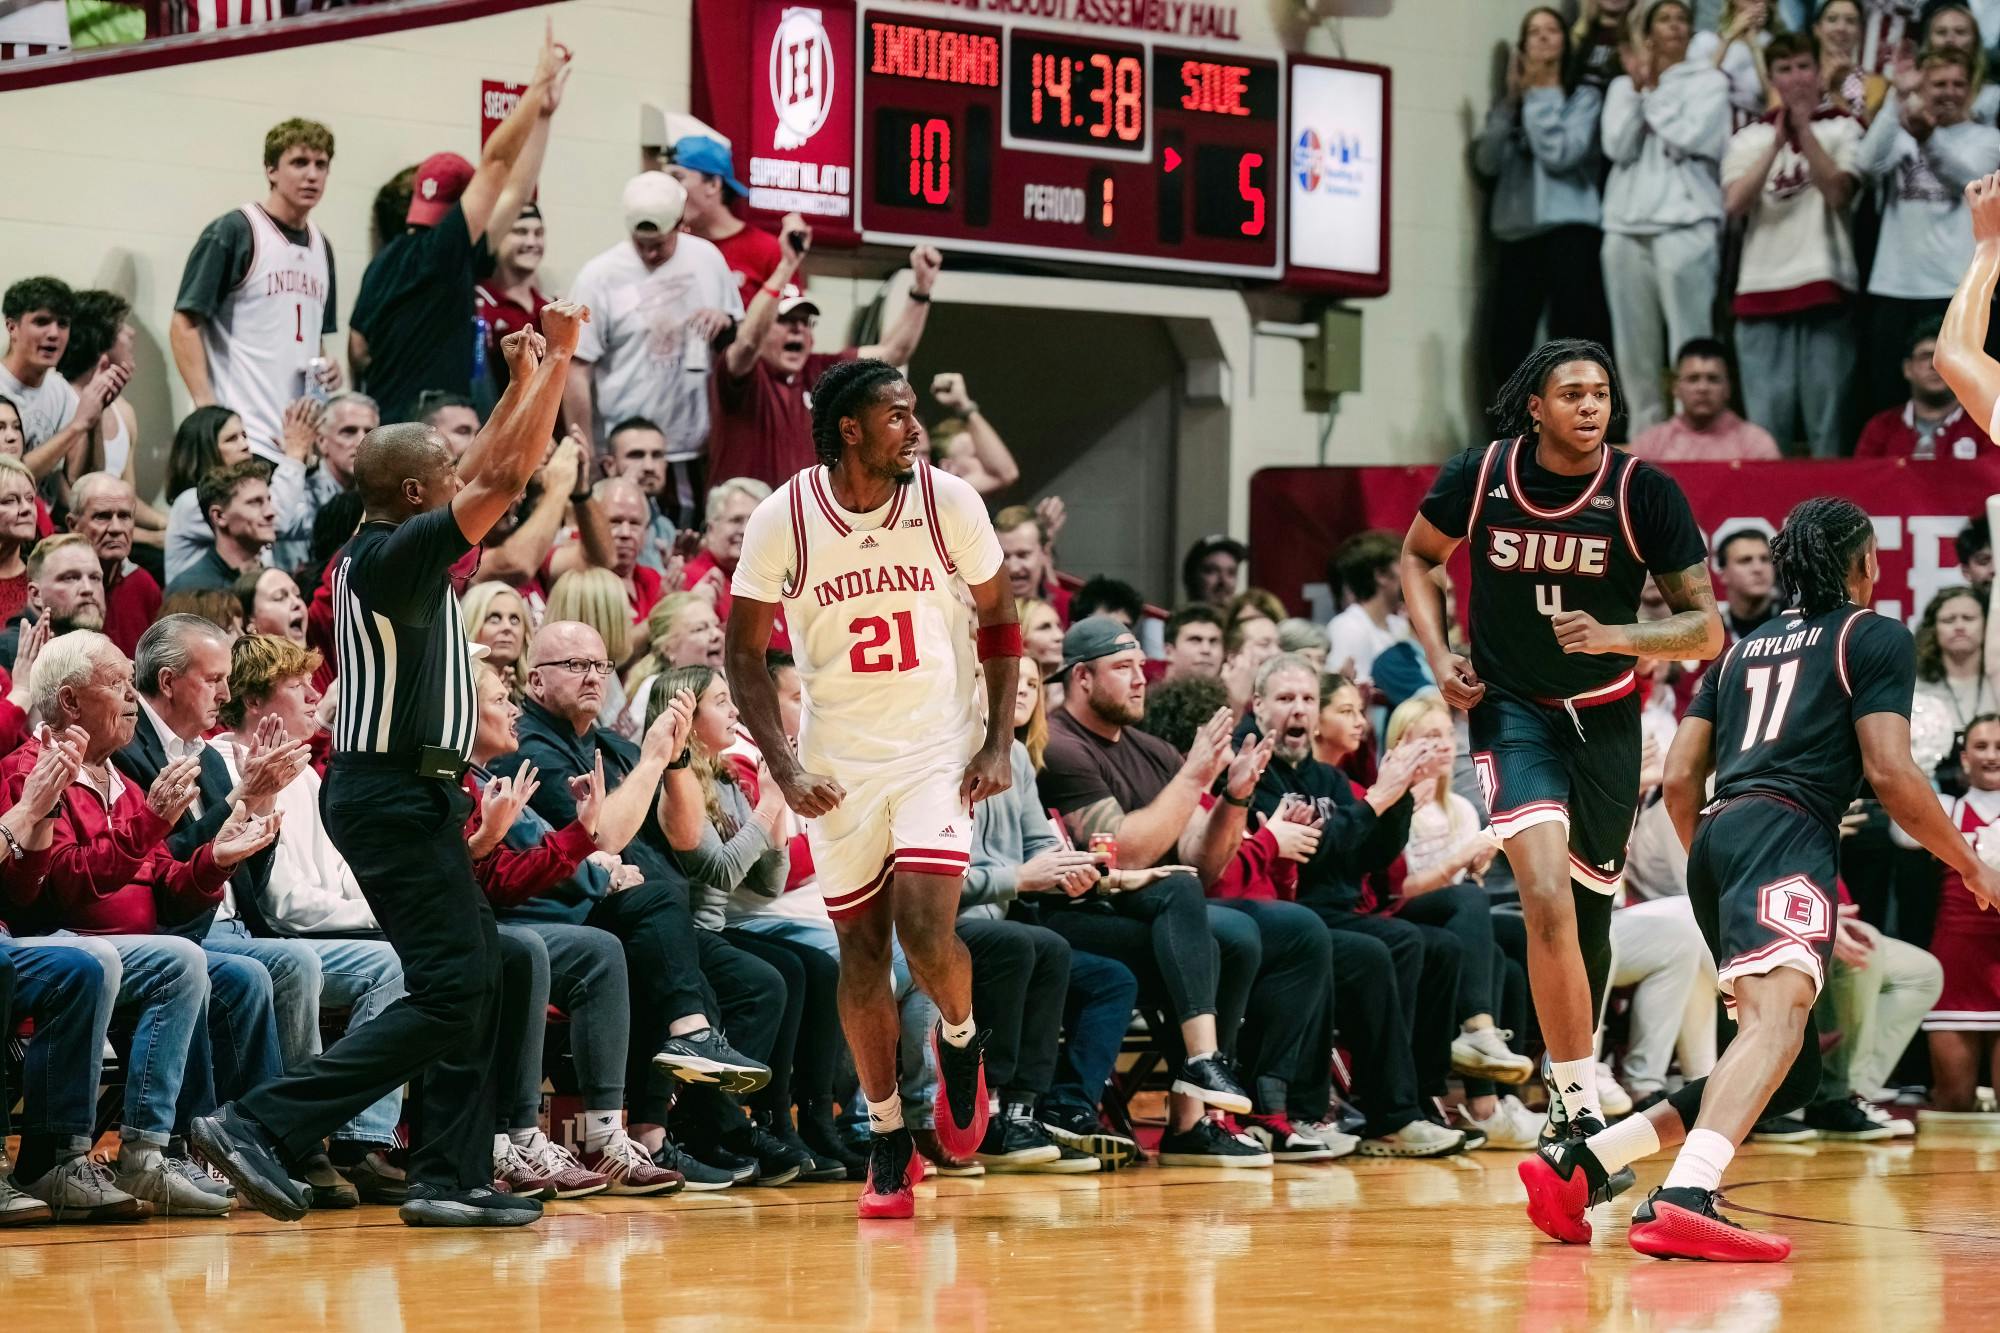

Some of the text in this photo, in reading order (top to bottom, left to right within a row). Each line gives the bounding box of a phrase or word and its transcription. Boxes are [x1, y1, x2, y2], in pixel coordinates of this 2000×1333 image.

[1074, 0, 1187, 31] ASSEMBLY
[1189, 6, 1240, 40] HALL
[872, 23, 998, 87] INDIANA
[1032, 53, 1141, 140] 14:38
[1181, 61, 1250, 116] SIUE
[909, 119, 951, 205] 10
[1024, 183, 1086, 225] PERIOD
[1103, 178, 1113, 227] 1
[1239, 153, 1265, 235] 5
[296, 304, 303, 342] 1
[1488, 528, 1609, 576] SIUE
[814, 565, 935, 607] INDIANA
[849, 610, 919, 672] 21
[1742, 627, 1823, 659] TAYLOR II
[1740, 659, 1800, 752] 11
[1784, 890, 1813, 926] E
